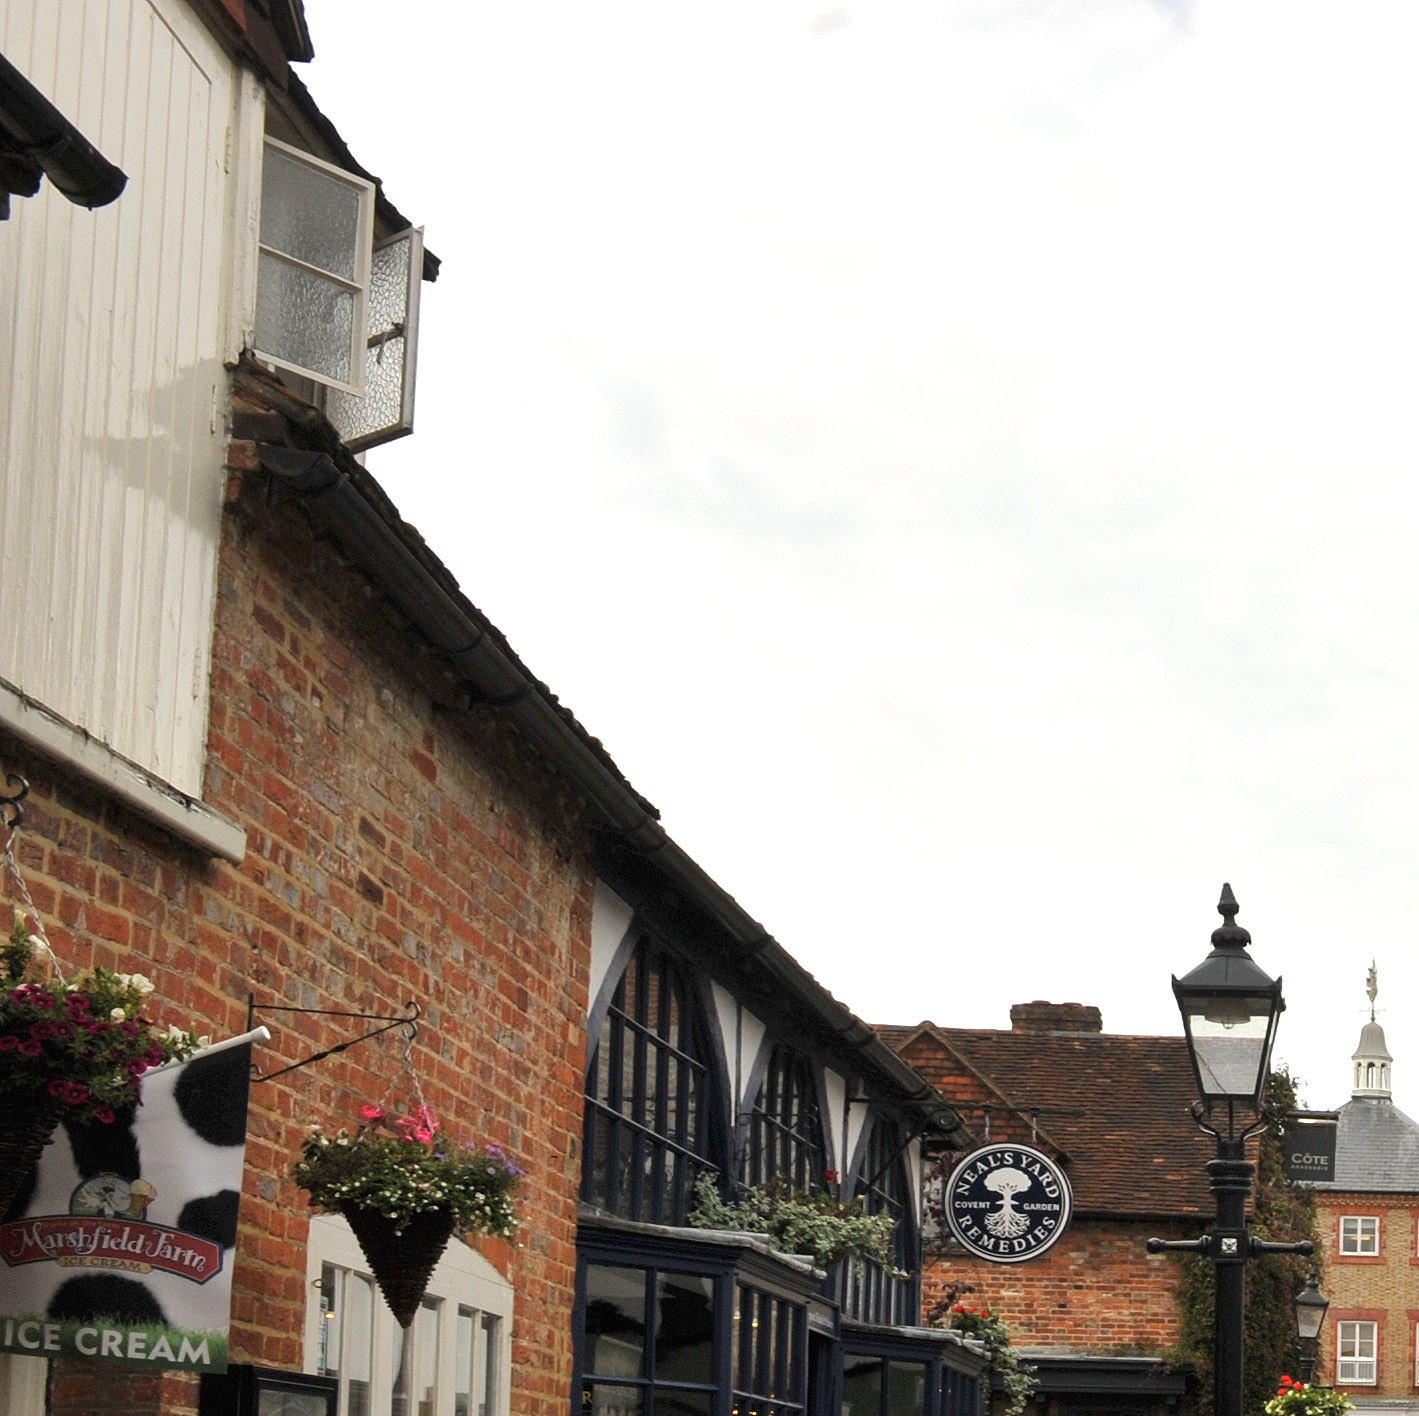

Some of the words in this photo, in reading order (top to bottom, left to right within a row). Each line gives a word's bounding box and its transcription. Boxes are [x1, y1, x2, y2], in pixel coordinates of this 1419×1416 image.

[957, 1152, 1014, 1196] NEAL'S
[1020, 1154, 1060, 1198] YARD
[955, 1201, 990, 1209] COVENT
[1023, 1202, 1060, 1211] GARDEN
[11, 1222, 143, 1258] Marshfield
[146, 1229, 207, 1272] Farm
[959, 1214, 1056, 1253] REMEDIES
[63, 1257, 86, 1267] ICE
[90, 1258, 142, 1271] CREAM
[4, 1320, 61, 1350] ICE
[75, 1327, 211, 1365] CREAM
